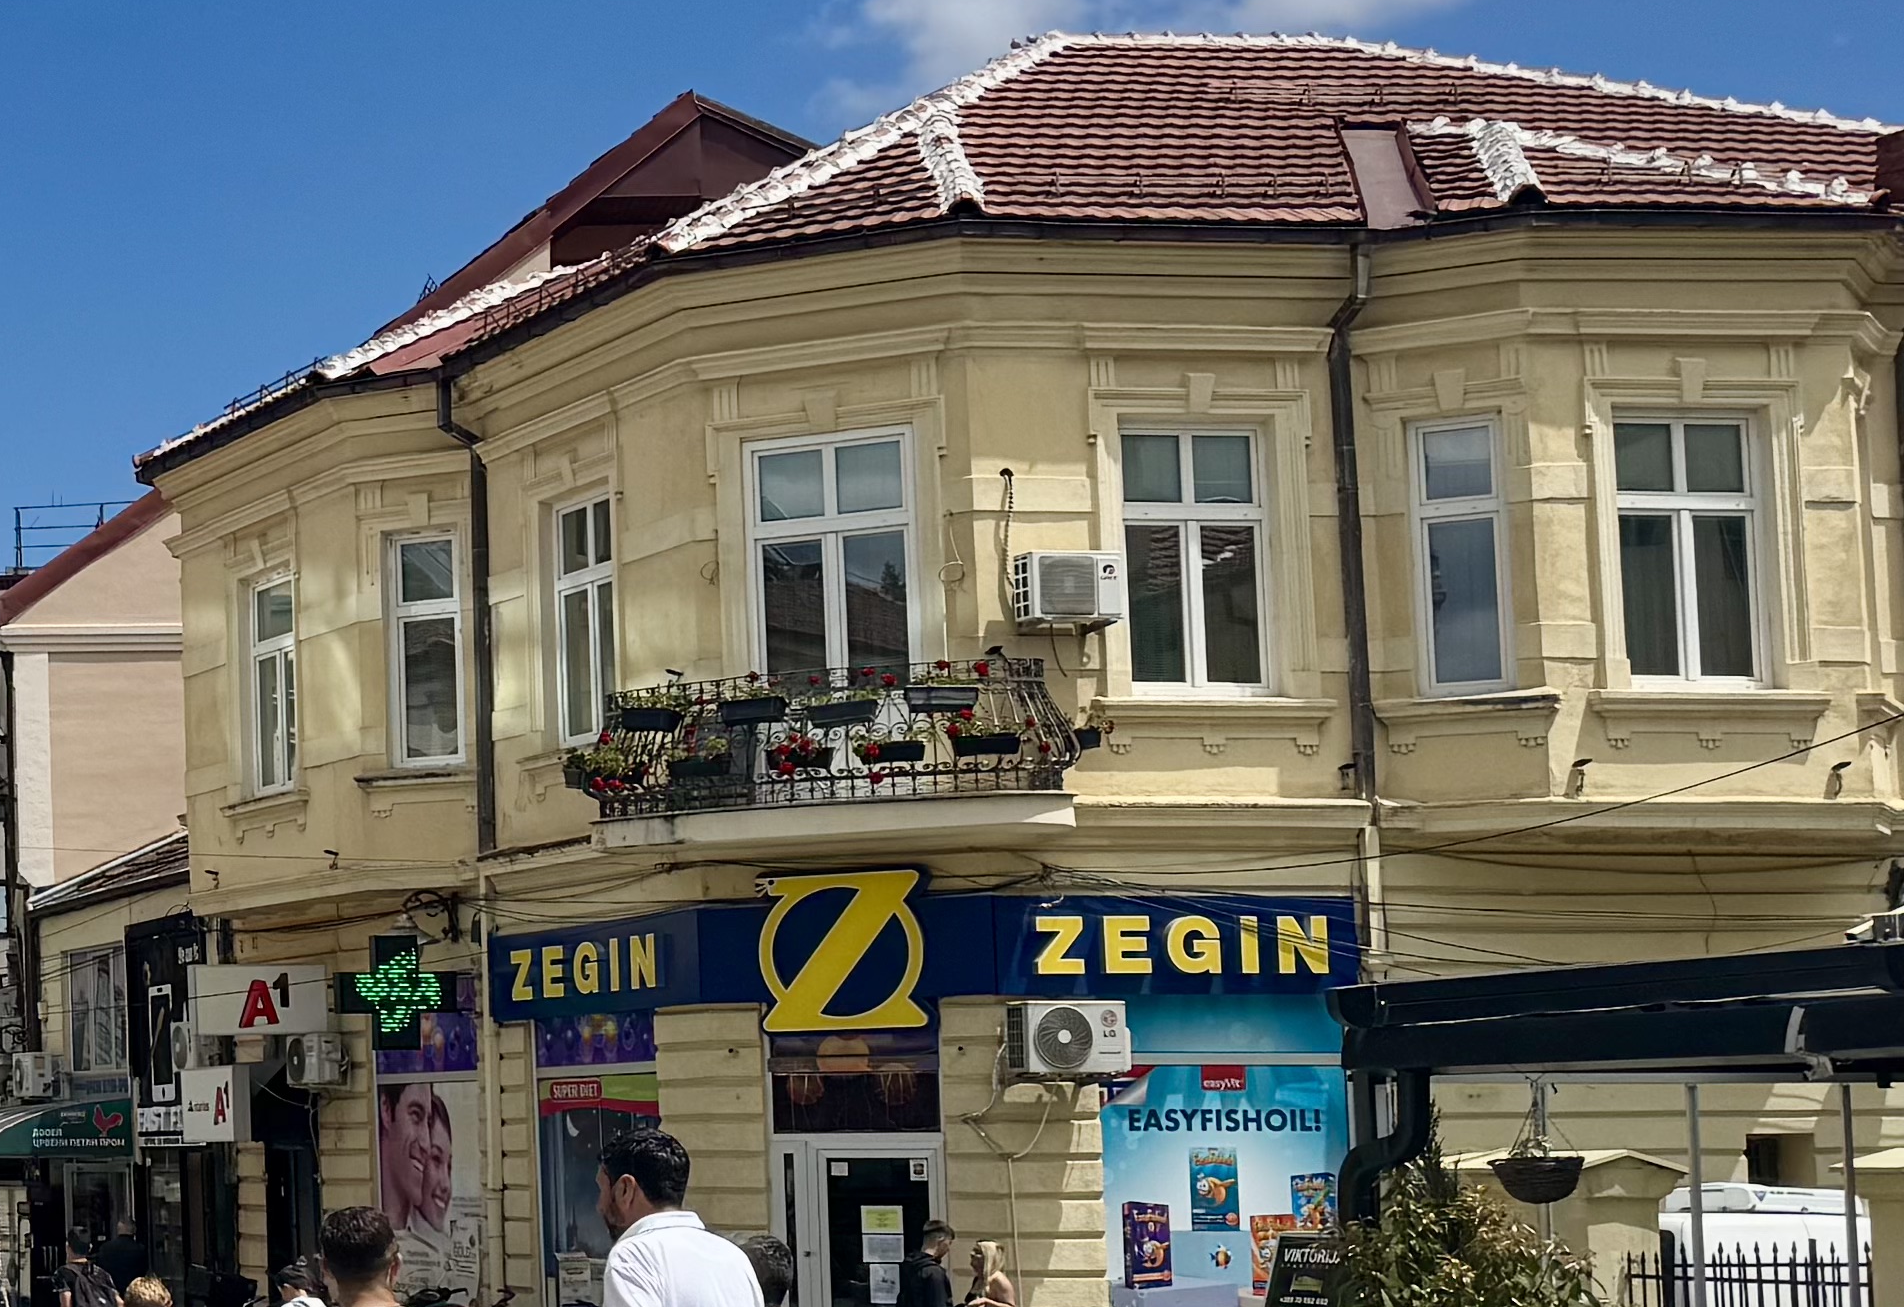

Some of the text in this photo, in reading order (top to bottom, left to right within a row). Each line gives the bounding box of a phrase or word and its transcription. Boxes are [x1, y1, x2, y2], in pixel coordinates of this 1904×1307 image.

[510, 933, 656, 1002] ZEGIN
[1033, 915, 1330, 974] ZEGIN
[239, 972, 290, 1028] A1
[213, 1080, 230, 1126] A1
[552, 1083, 599, 1099] SUPER DIET
[1128, 1108, 1322, 1133] EASYFISHOIL!
